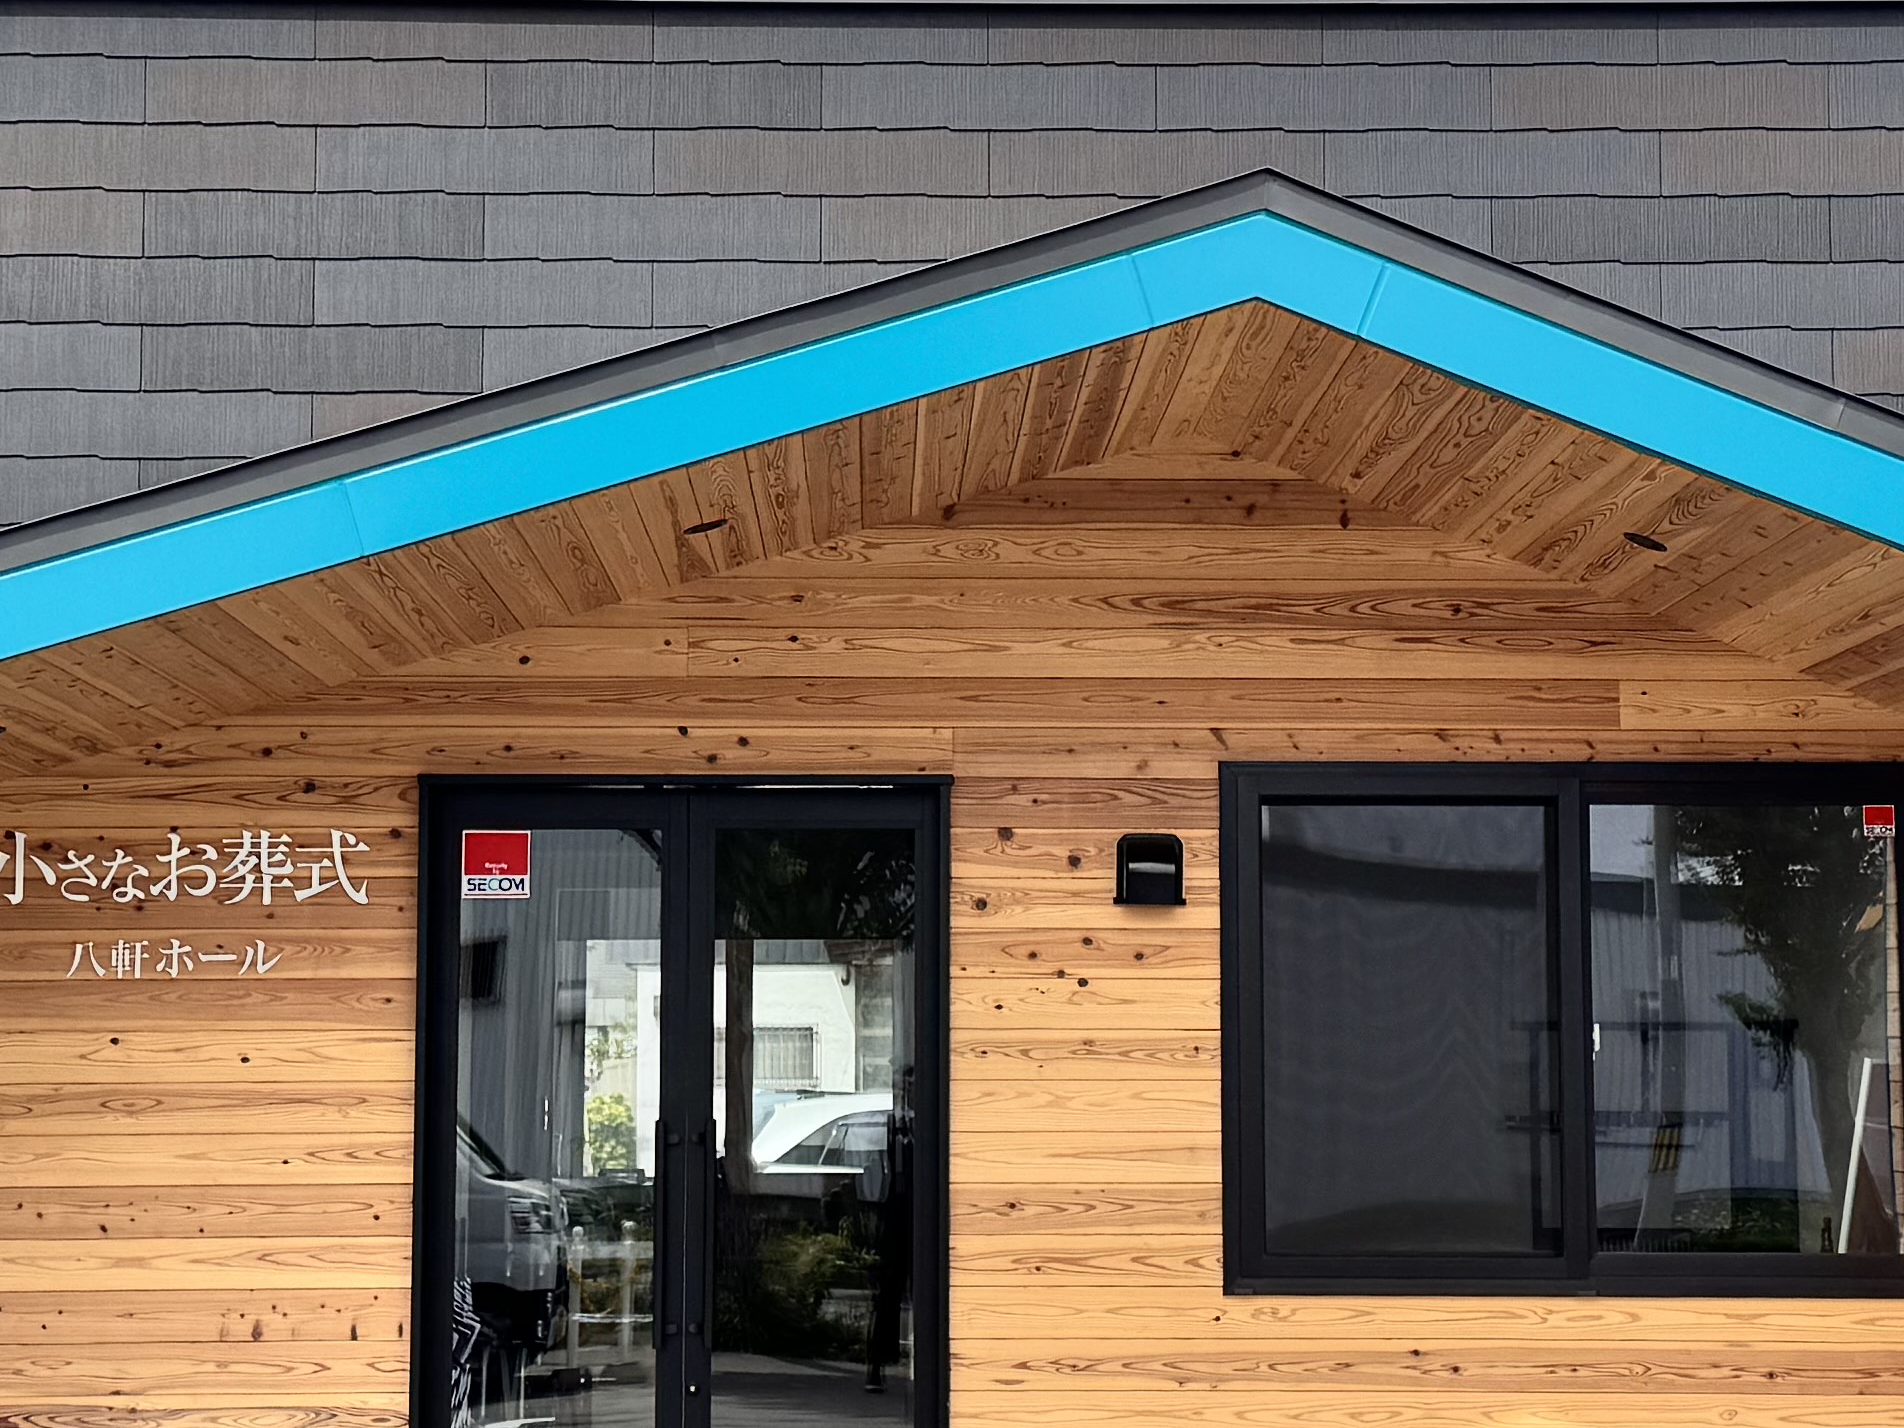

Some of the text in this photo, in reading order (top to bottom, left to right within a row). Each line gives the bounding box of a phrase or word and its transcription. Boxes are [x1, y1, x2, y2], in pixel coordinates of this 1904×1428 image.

[467, 877, 525, 892] SECOM
[66, 939, 282, 979] 八軒ホール
